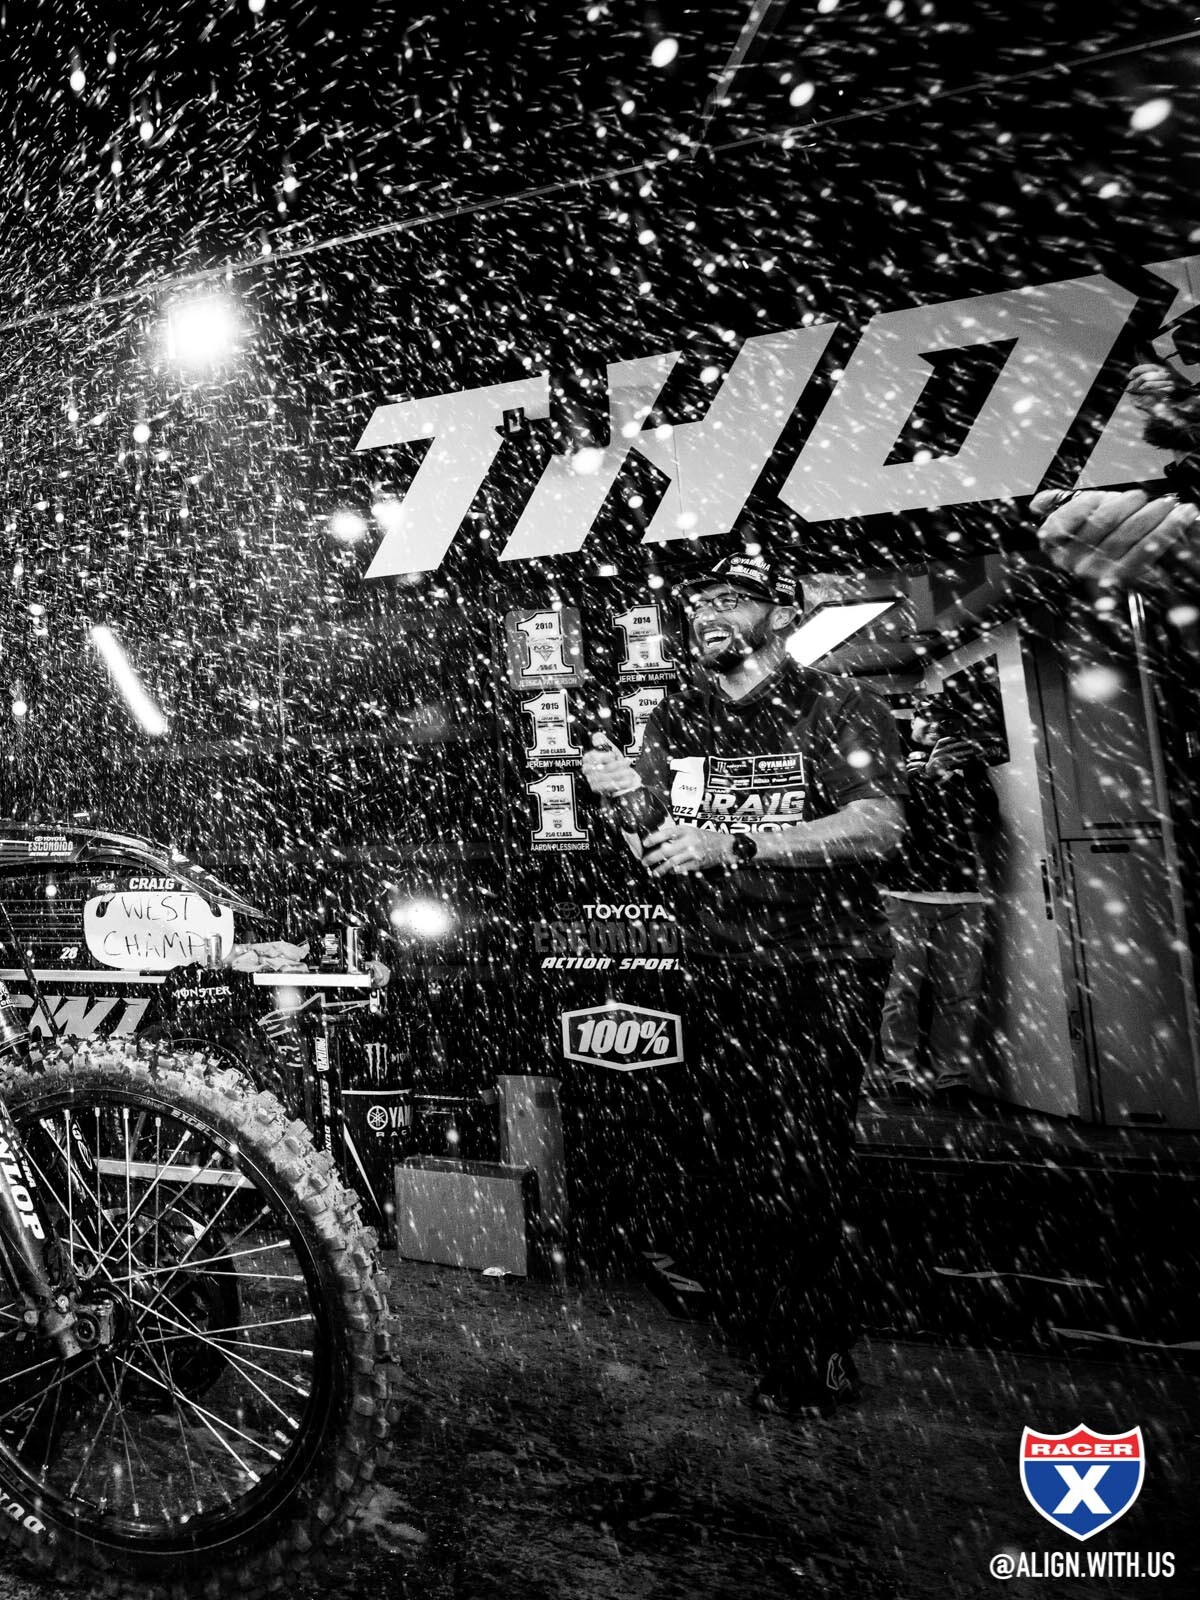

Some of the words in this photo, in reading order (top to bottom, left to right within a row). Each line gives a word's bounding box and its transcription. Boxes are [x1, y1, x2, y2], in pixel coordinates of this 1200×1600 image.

[618, 674, 646, 683] JEREMY
[648, 672, 676, 681] MARTIN
[540, 702, 560, 711] 2015
[525, 760, 554, 769] JEREMY
[555, 758, 582, 768] MARTIN
[129, 877, 174, 890] CRAIG
[121, 894, 195, 922] WEST
[583, 904, 669, 919] TOYOTA
[60, 946, 79, 960] 28
[541, 957, 612, 970] ACTION
[577, 1019, 670, 1055] 100%
